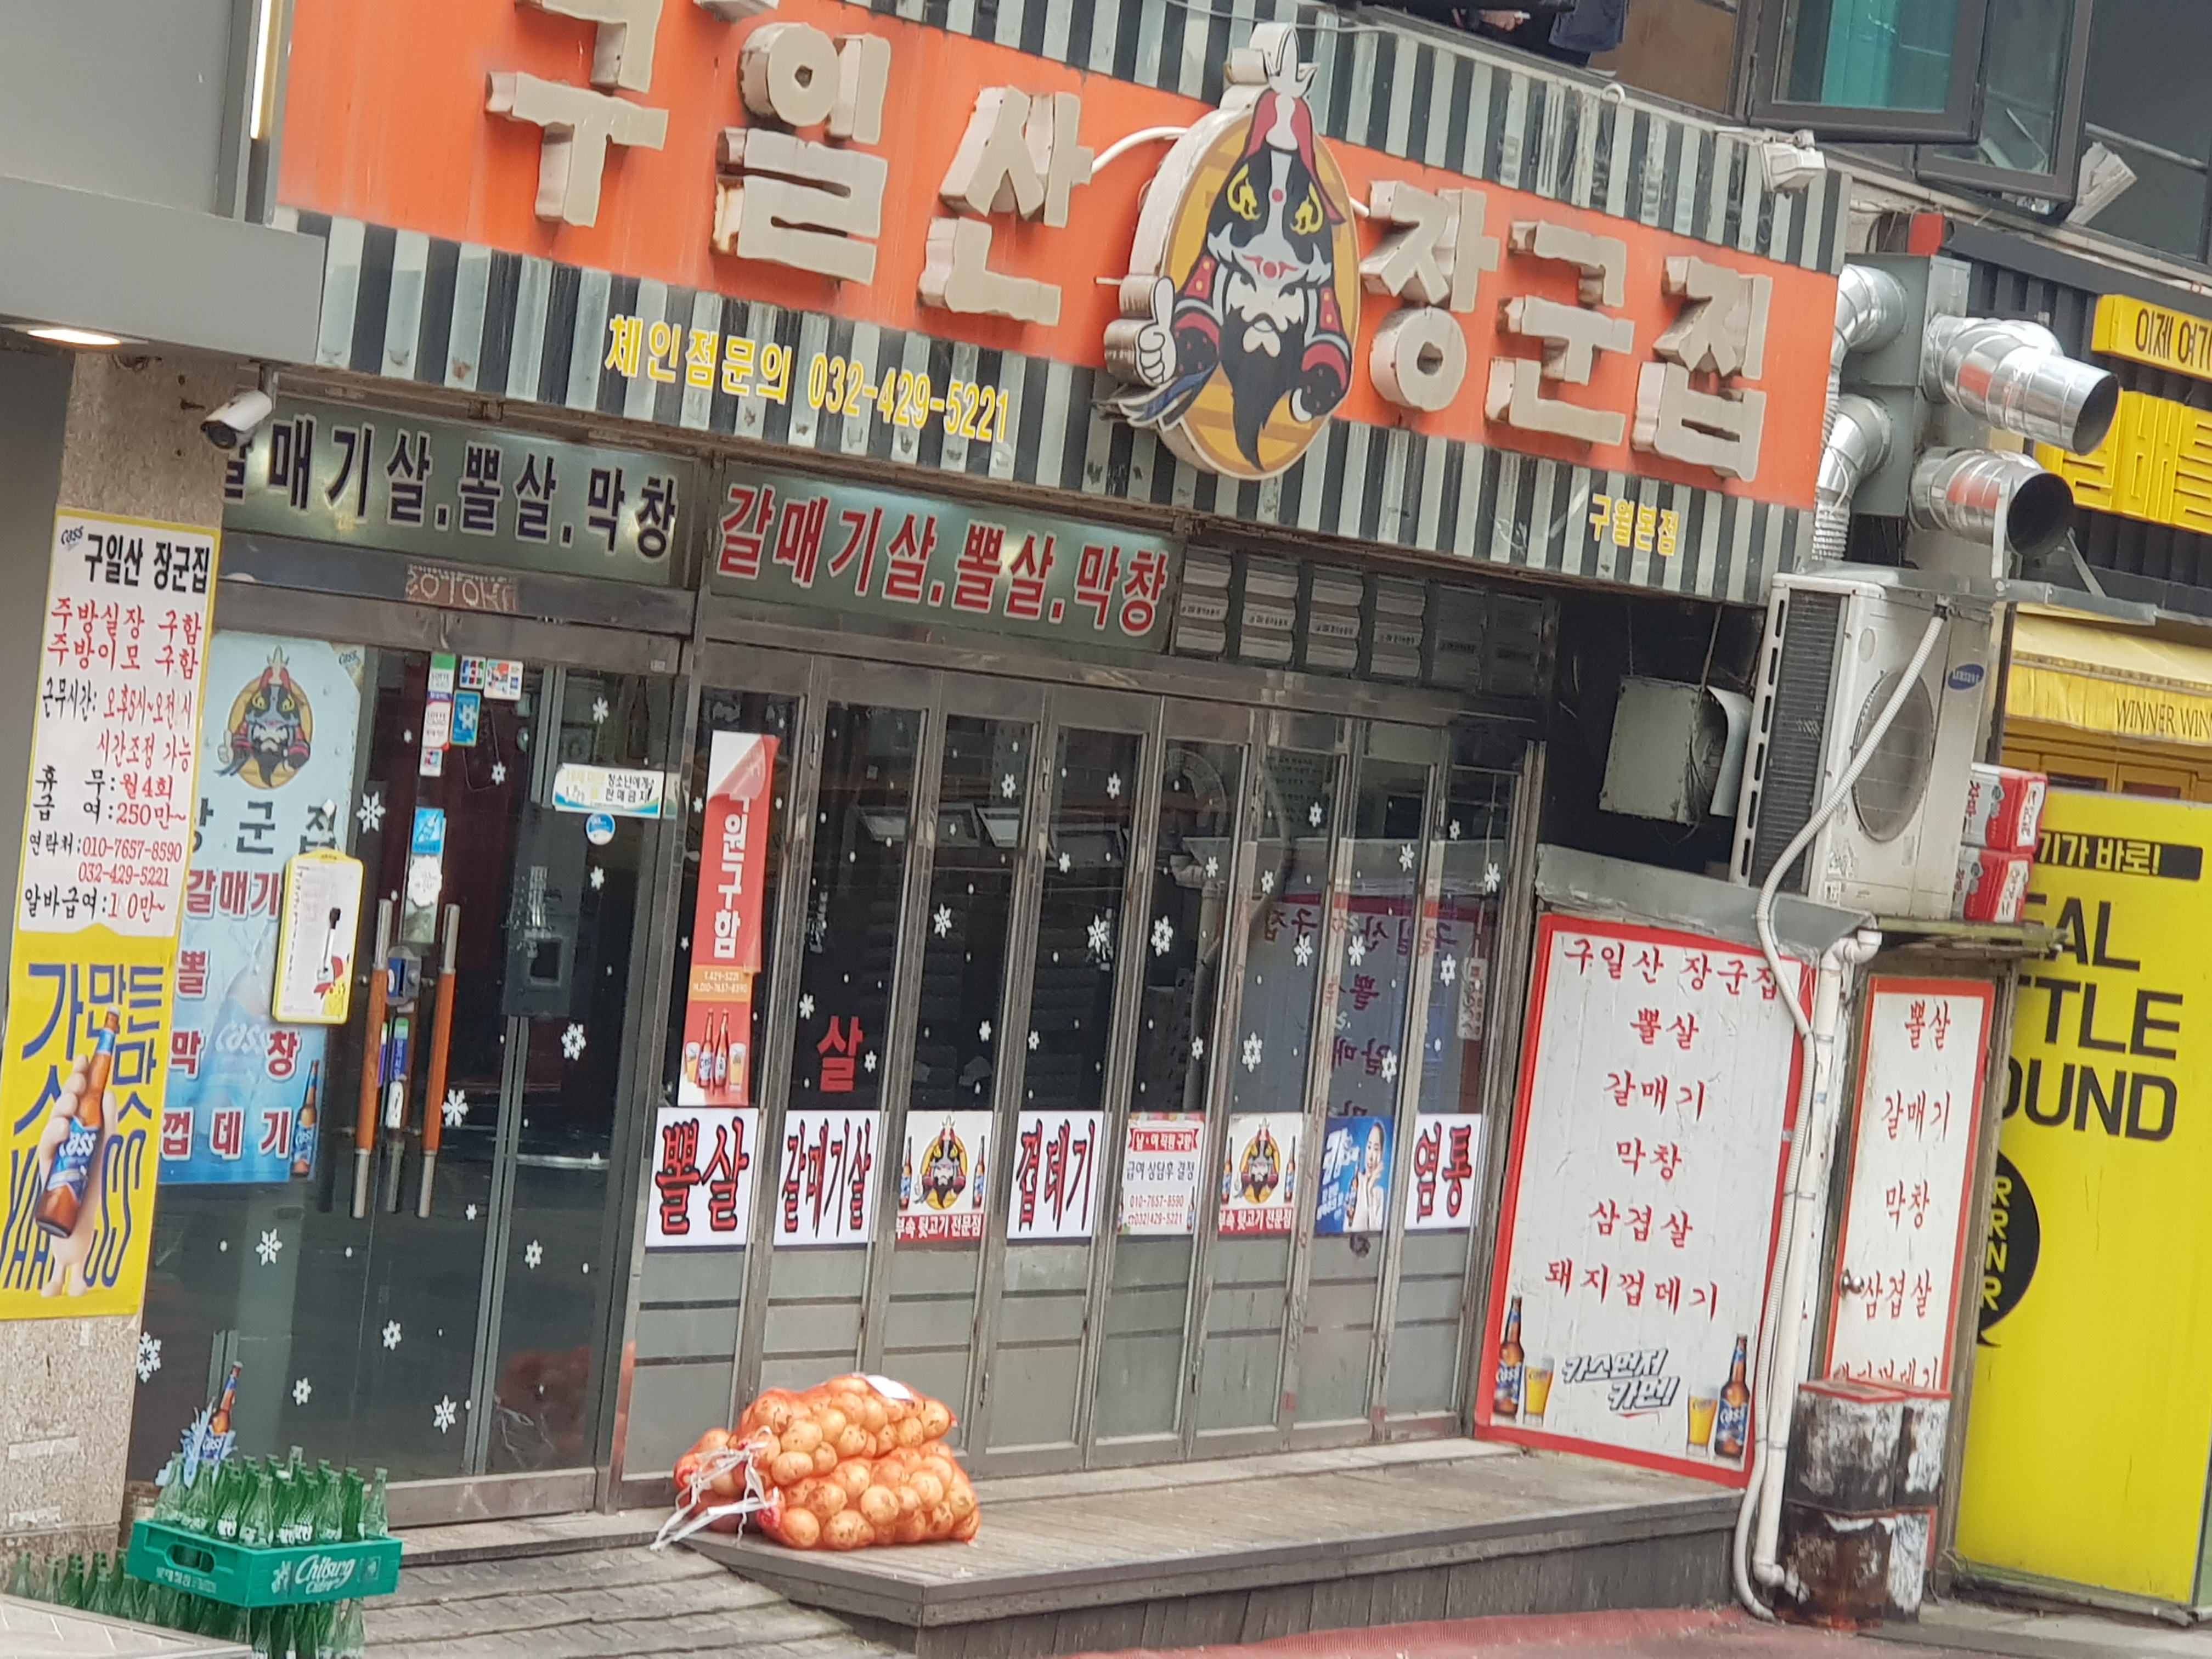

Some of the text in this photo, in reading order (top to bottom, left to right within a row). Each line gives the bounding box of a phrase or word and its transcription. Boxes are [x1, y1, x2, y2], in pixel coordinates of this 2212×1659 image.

[486, 0, 1093, 326] 구일산
[1360, 180, 1771, 482] 장군집
[2135, 308, 2174, 360] 이제
[605, 314, 1010, 443] 체인점문의 032-429-5221
[1589, 493, 1679, 556] 구월본점
[84, 533, 211, 594] 구일산 장군집
[51, 596, 202, 646] 주방실장 구함
[48, 633, 199, 680] 주방이모 구함
[2116, 697, 2212, 738] WINNER WIN
[97, 728, 191, 772] 시간조정 가능
[78, 862, 170, 888] 032-429-5221
[82, 836, 183, 863] 010-7657-8590
[2095, 843, 2162, 876] 바로!
[185, 868, 280, 917] 갈매기
[714, 796, 750, 958] 원구함
[1564, 939, 1777, 1001] 구일산 장군집
[1630, 1007, 1699, 1051] 뽈살
[1905, 999, 1950, 1050] 뽈살
[817, 1015, 865, 1092] 살
[1604, 1070, 1705, 1122] 갈매기
[1881, 1090, 1951, 1143] 갈매기
[655, 1115, 749, 1235] 뽈살
[781, 1118, 871, 1239] 갈매기살
[1413, 1121, 1473, 1225] 염통
[1616, 1137, 1682, 1181] 막창
[951, 1214, 982, 1237] 전문점
[1589, 1199, 1694, 1249] 삼겹살
[1884, 1179, 1931, 1231] 막창
[1545, 1257, 1718, 1323] 돼지껍데기
[1861, 1268, 1932, 1321] 삼겹살
[1562, 1347, 1669, 1384] 카스먼저
